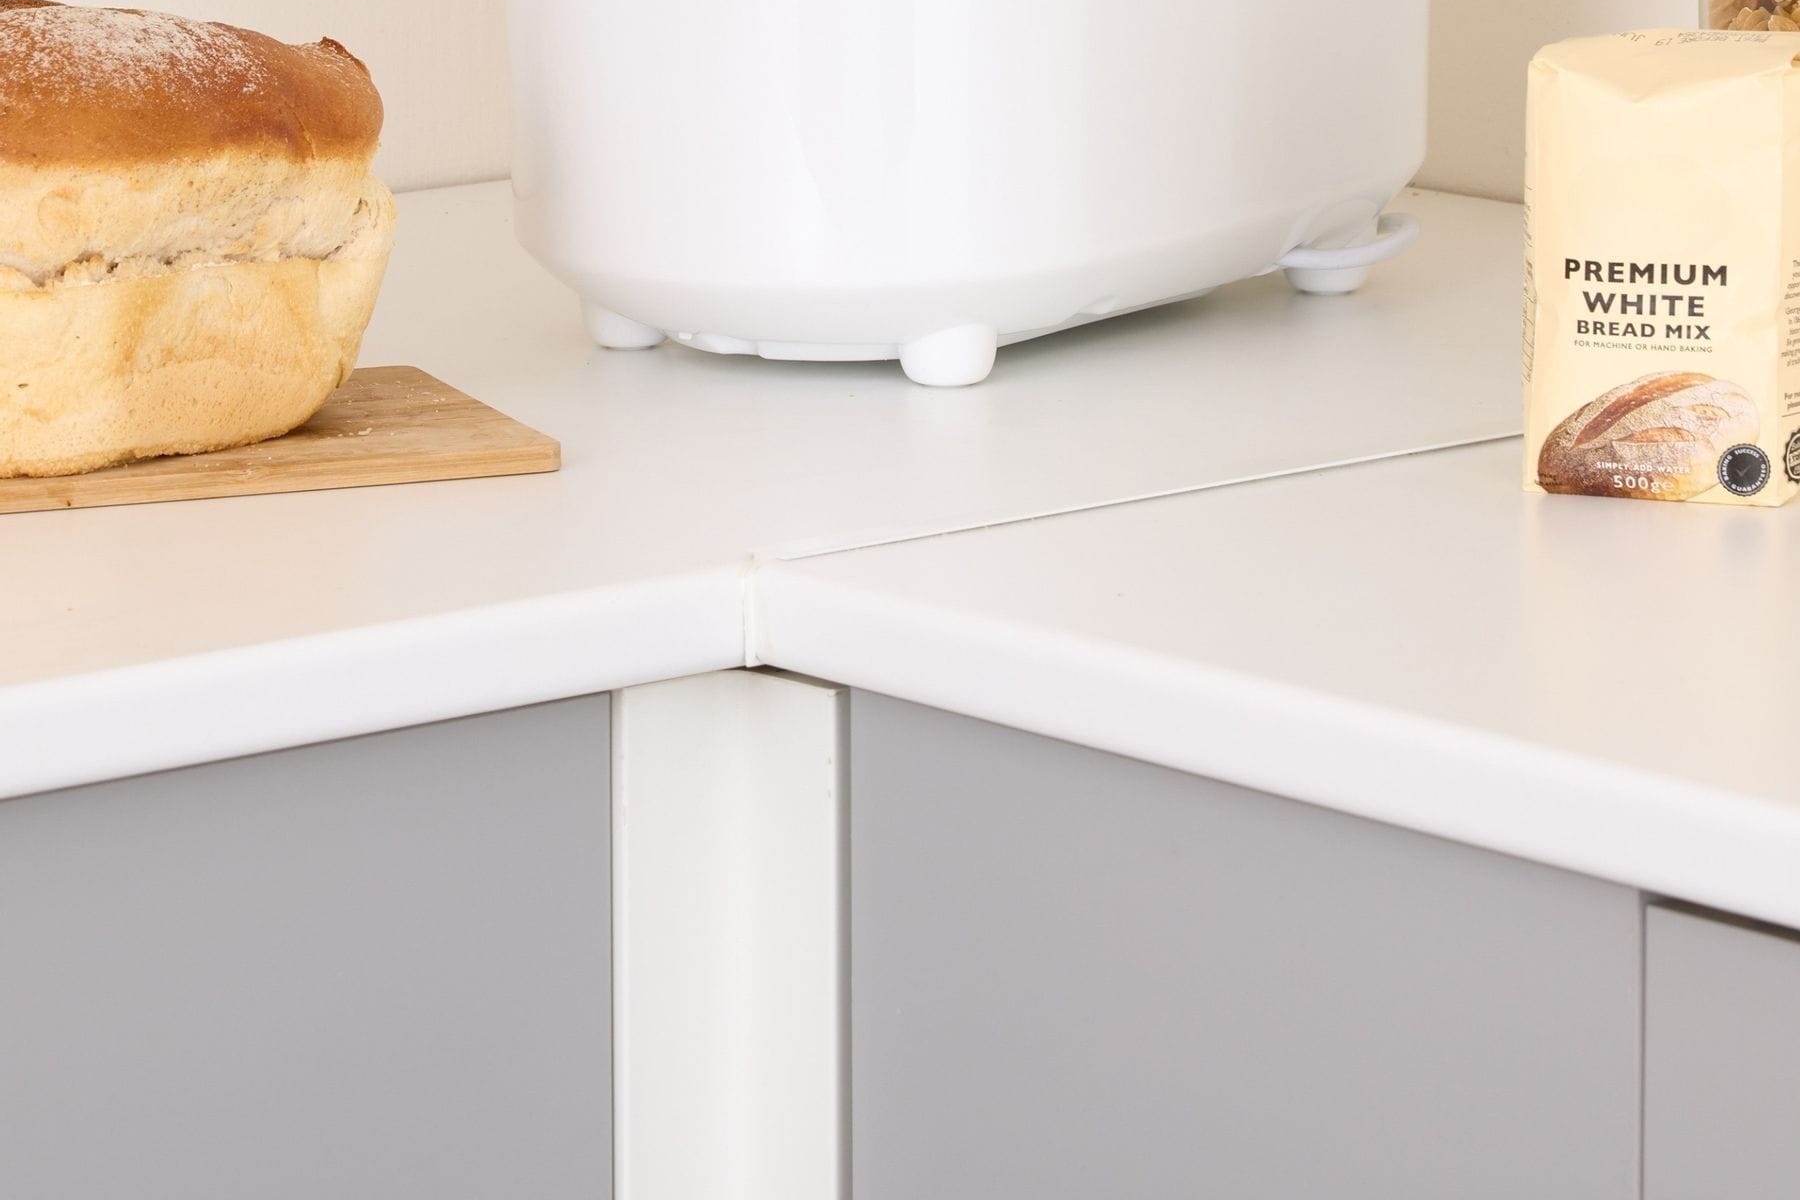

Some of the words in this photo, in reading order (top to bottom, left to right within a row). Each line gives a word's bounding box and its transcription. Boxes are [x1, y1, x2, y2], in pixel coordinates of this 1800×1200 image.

[1564, 258, 1728, 287] PREMIUM
[1582, 291, 1706, 318] WHITE
[1576, 319, 1656, 339] BREAD
[1665, 324, 1711, 341] MIX
[1573, 339, 1591, 348] FOR
[1593, 340, 1633, 351] MACHINE
[1635, 342, 1649, 351] OR
[1650, 343, 1677, 352] HAND
[1679, 345, 1713, 354] BAKING
[1595, 460, 1629, 472] SIMPLY
[1632, 462, 1653, 473] ADD
[1656, 465, 1691, 475] WATER
[1721, 454, 1733, 482] BAKING
[1733, 447, 1760, 459] SUCCESS
